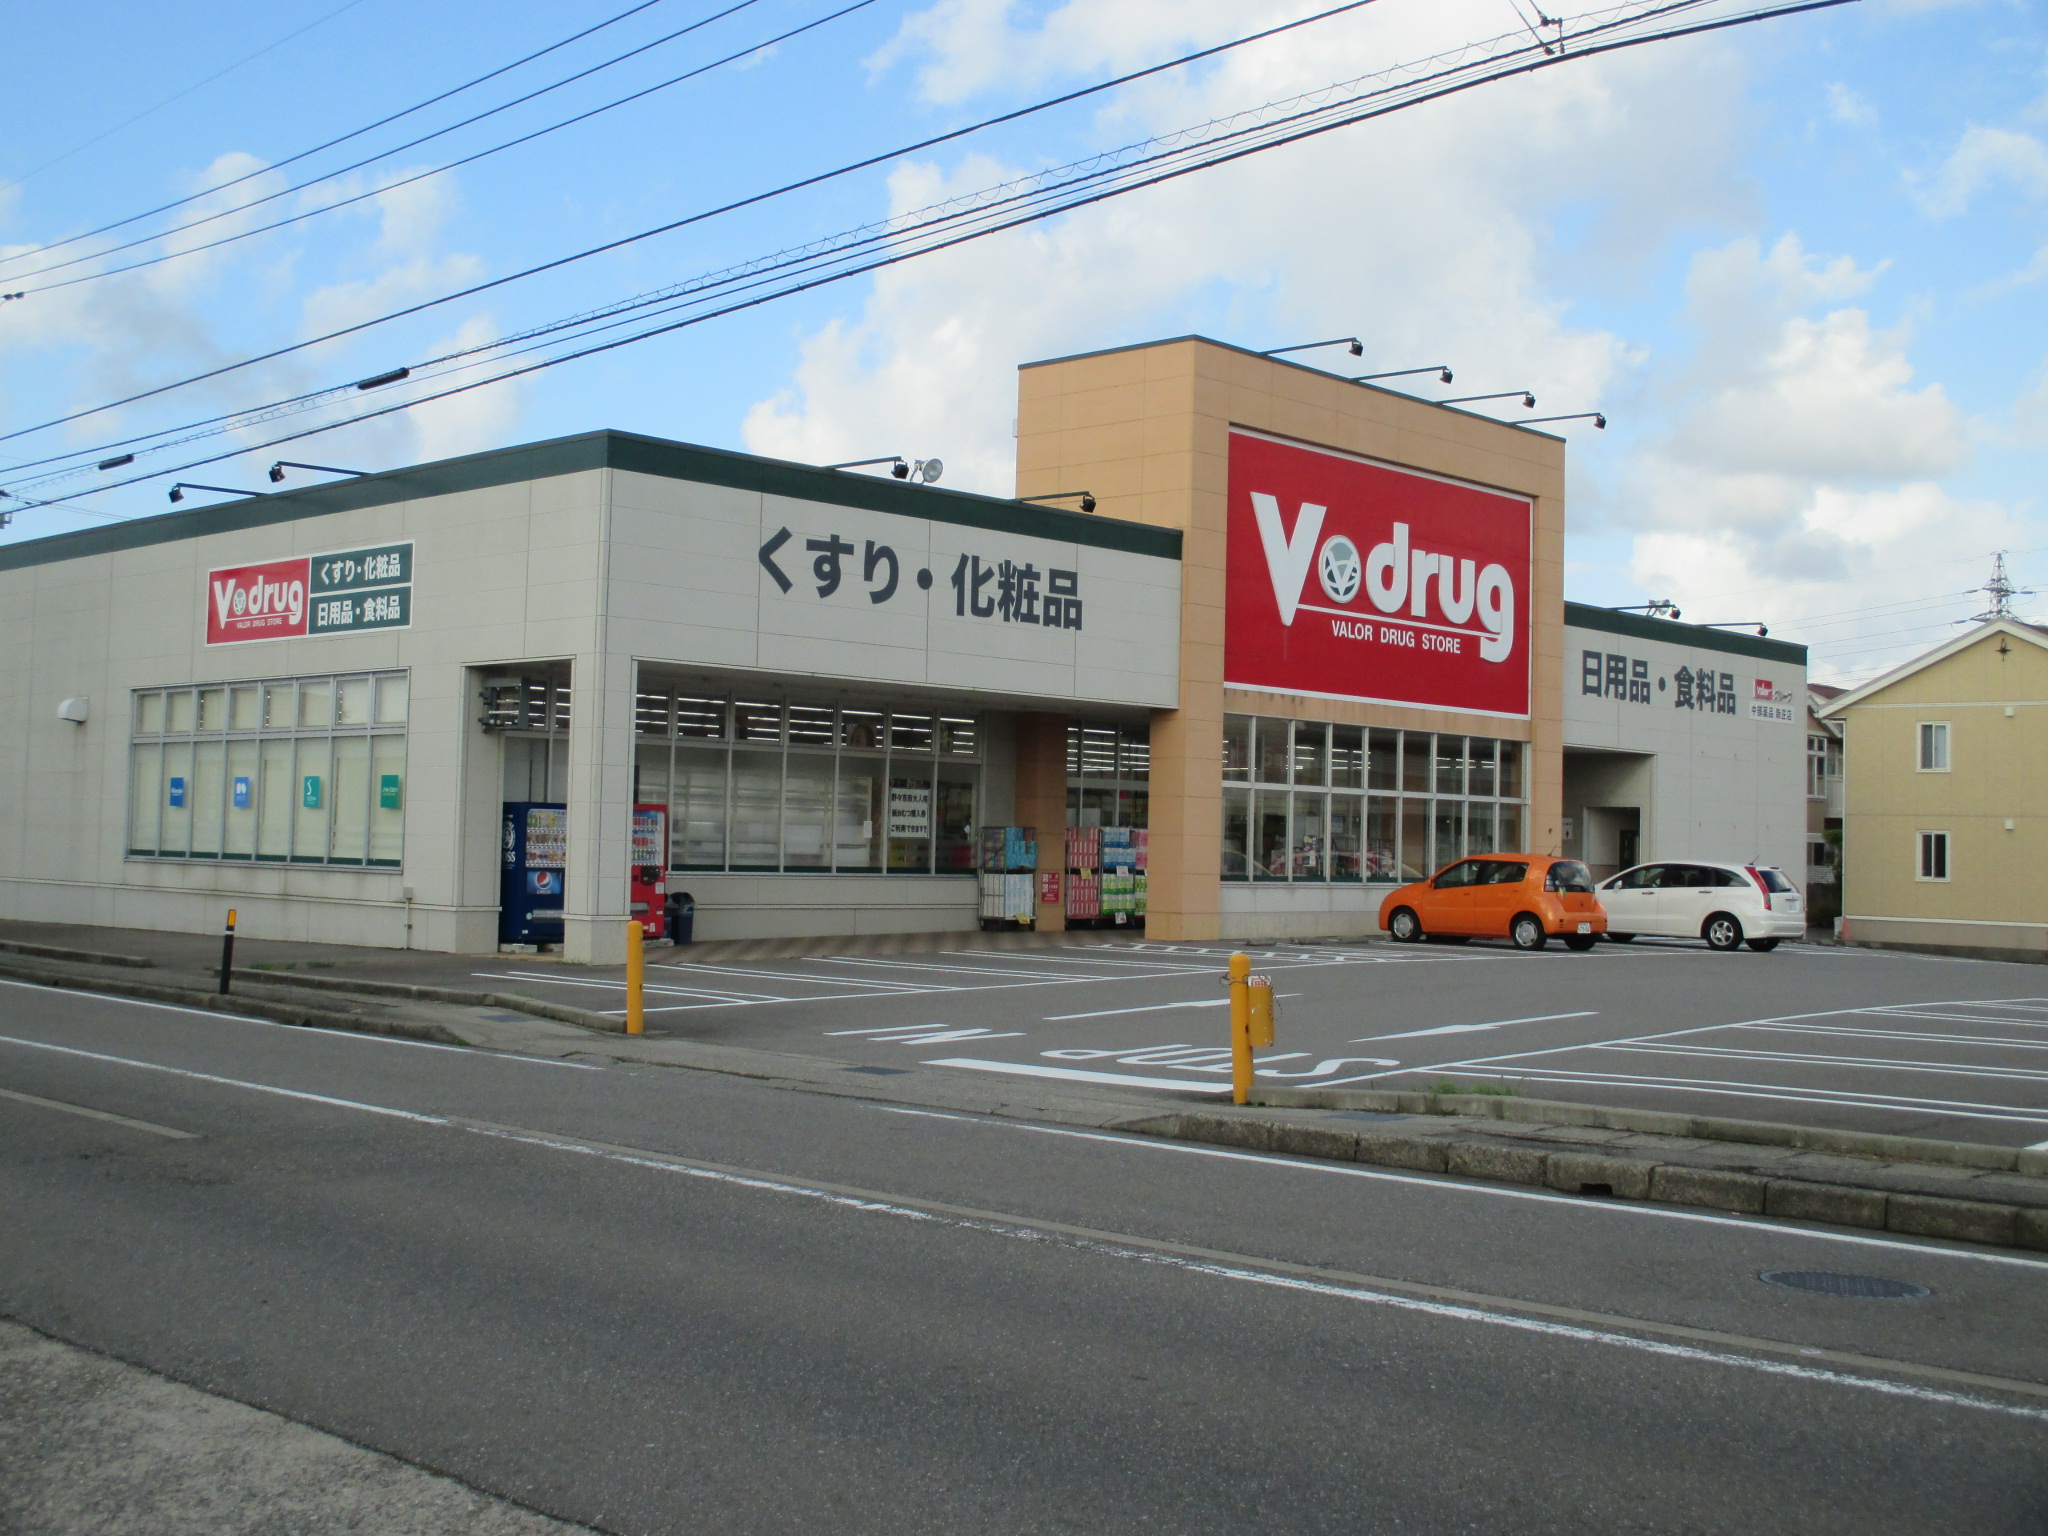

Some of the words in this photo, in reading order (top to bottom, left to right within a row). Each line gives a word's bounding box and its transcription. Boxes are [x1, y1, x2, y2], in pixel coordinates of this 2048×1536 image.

[320, 553, 401, 585] くすり・化粧品
[758, 526, 1083, 630] くすり・化粧品
[237, 618, 251, 629] VALOR
[252, 617, 265, 627] DRUG
[267, 617, 283, 626] STORE
[317, 595, 400, 627] 日用品・食料品
[1331, 620, 1373, 641] VALOR
[1380, 627, 1415, 648] DRUG
[1422, 633, 1461, 654] STORE
[1581, 650, 1736, 715] 日用品・食料品
[1040, 1044, 1401, 1078] STOP
